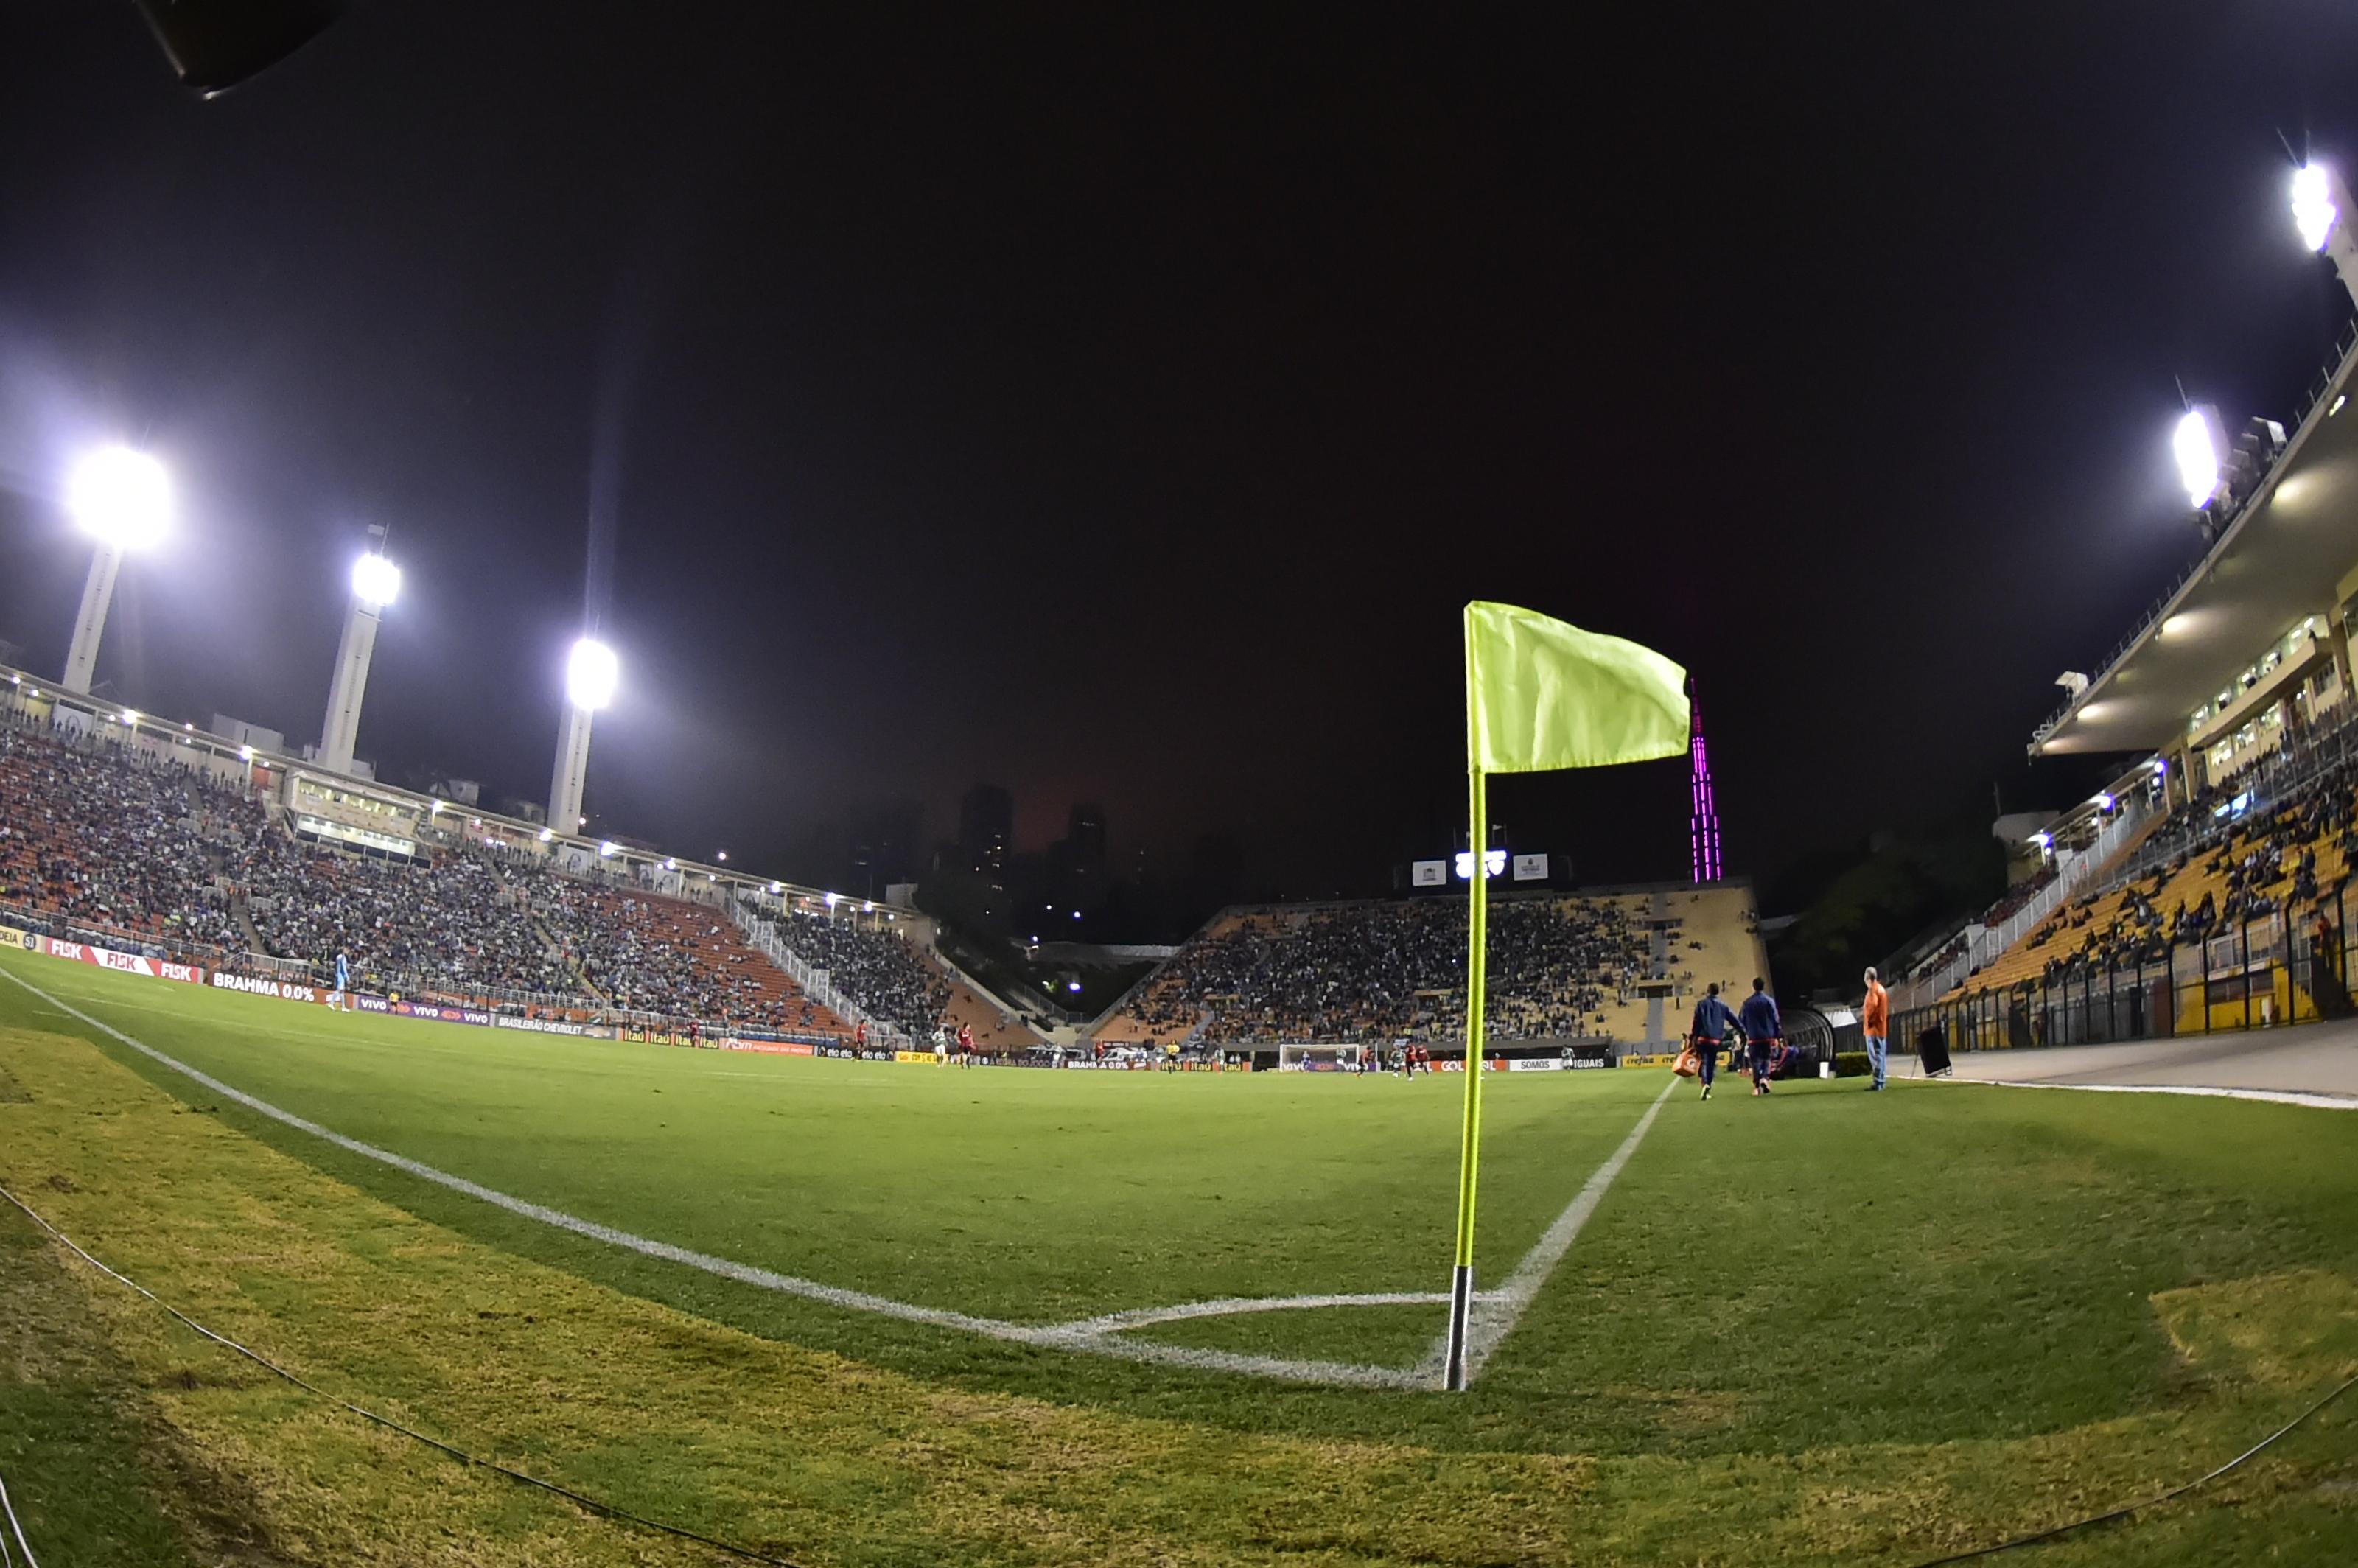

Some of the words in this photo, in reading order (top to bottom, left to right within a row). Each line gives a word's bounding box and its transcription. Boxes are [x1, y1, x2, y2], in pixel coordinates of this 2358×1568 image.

[51, 939, 83, 960] FISK
[107, 952, 136, 970] FISK
[161, 962, 192, 981] FISK
[213, 972, 279, 996] BRAHMA
[499, 1016, 543, 1031] BRASILEIRÃO
[543, 1022, 583, 1035] CHEVROLET
[1441, 1060, 1464, 1071] GOL
[1521, 1060, 1550, 1070] SOMOS
[1574, 1058, 1605, 1068] IGUAIS
[1626, 1056, 1654, 1066] crefisa
